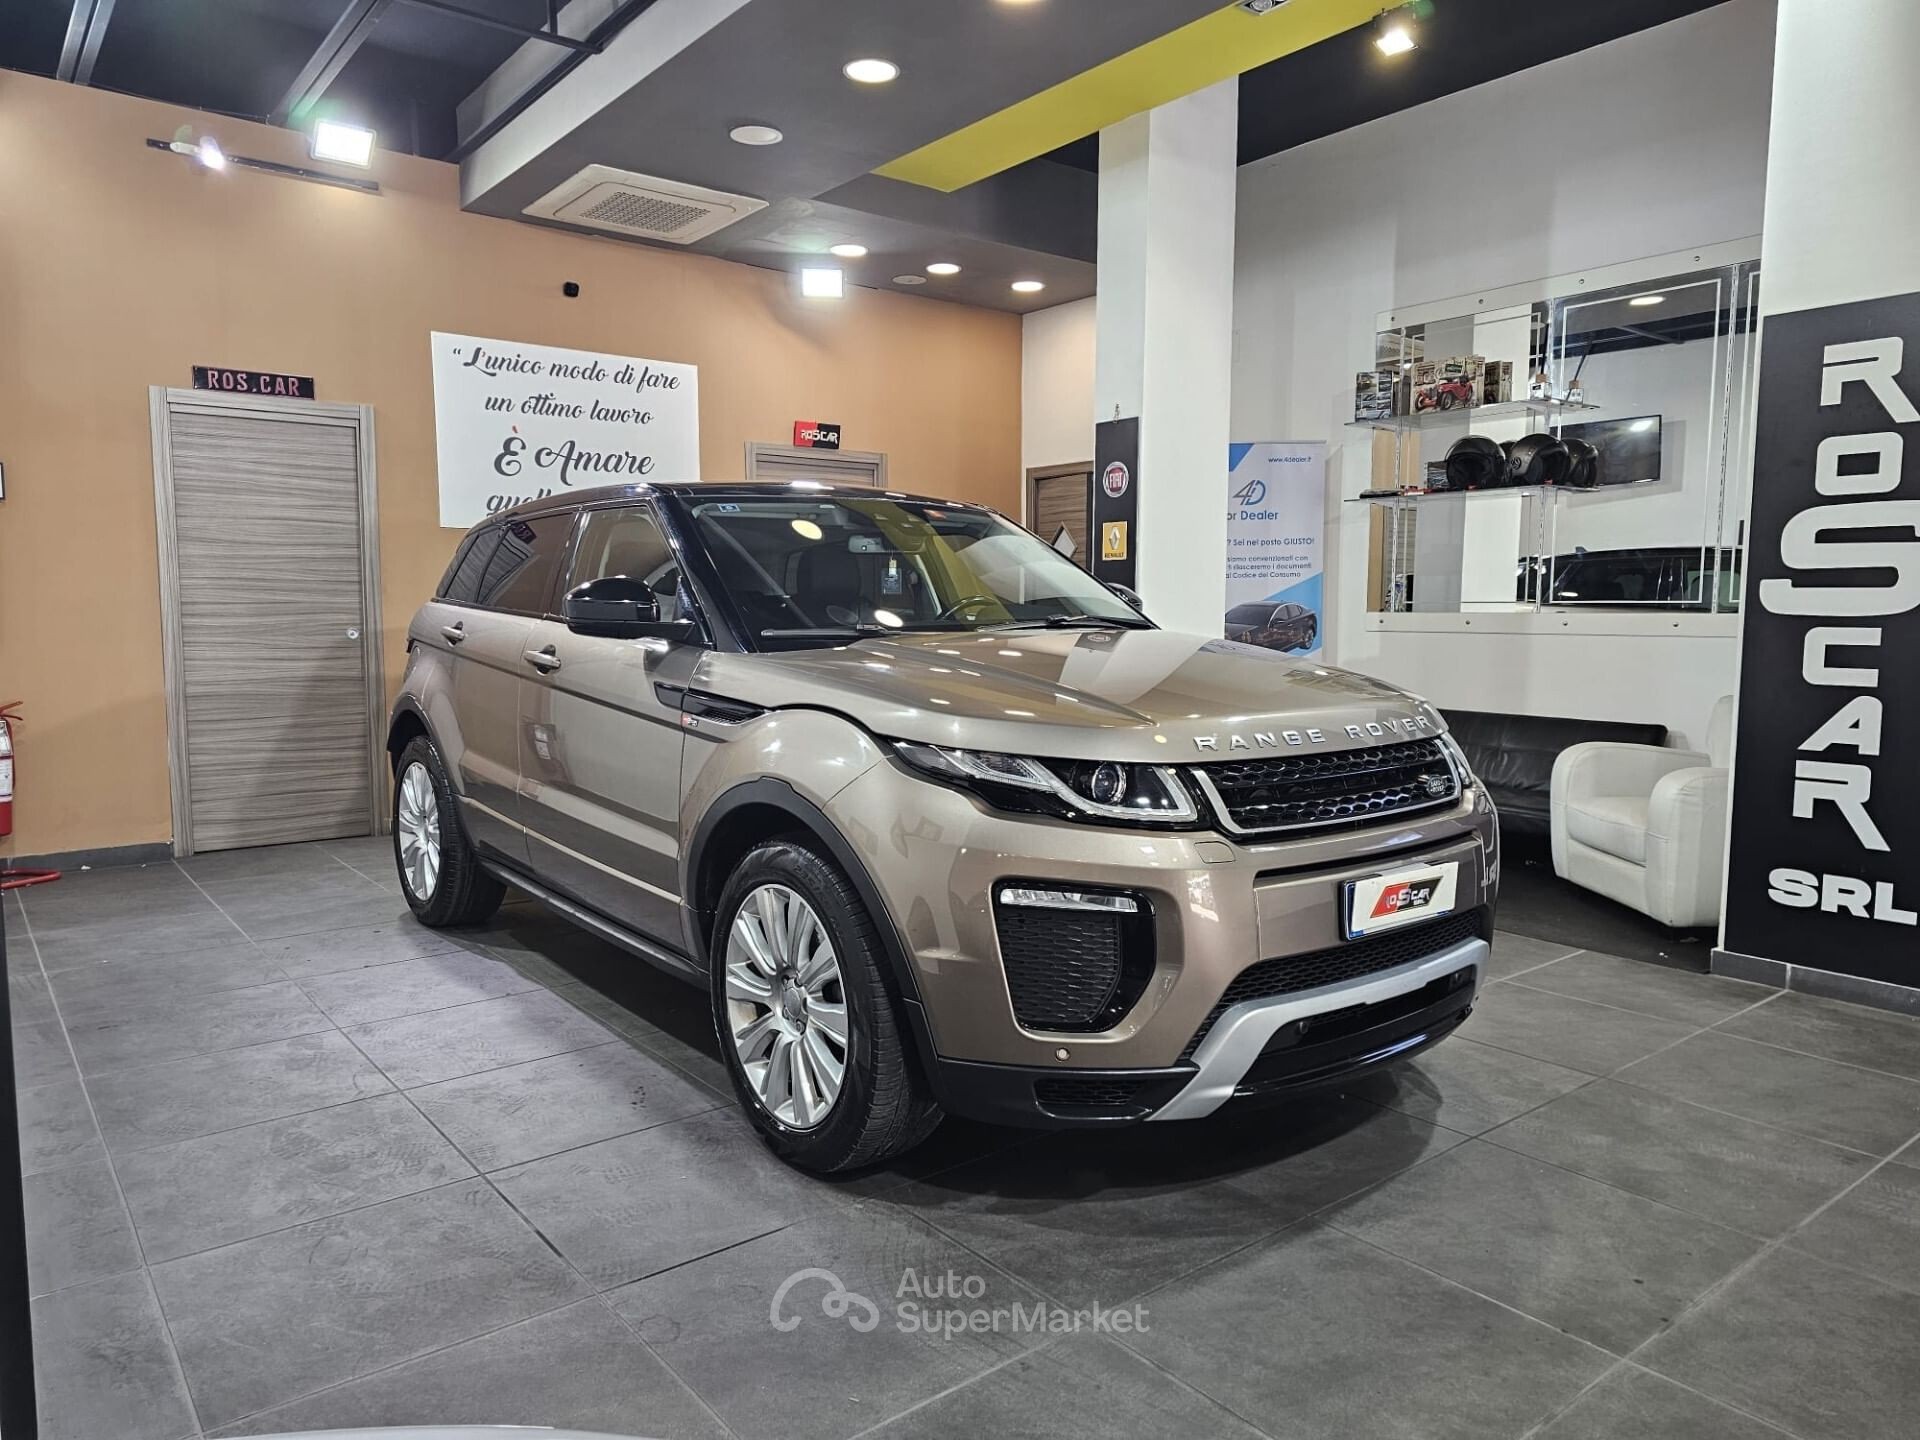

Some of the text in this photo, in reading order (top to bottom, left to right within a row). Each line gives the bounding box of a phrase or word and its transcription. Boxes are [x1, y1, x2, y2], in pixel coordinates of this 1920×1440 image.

[549, 361, 609, 382] modo
[613, 364, 636, 385] di
[635, 366, 681, 393] fare
[484, 392, 654, 425] un ottimo lavoro
[494, 425, 655, 487] È Amare
[1109, 472, 1123, 489] FIAT
[1240, 510, 1279, 520] Dealer
[1260, 538, 1282, 547] posto
[1193, 715, 1432, 752] RANGE ROVER
[1767, 867, 1918, 927] SRL
